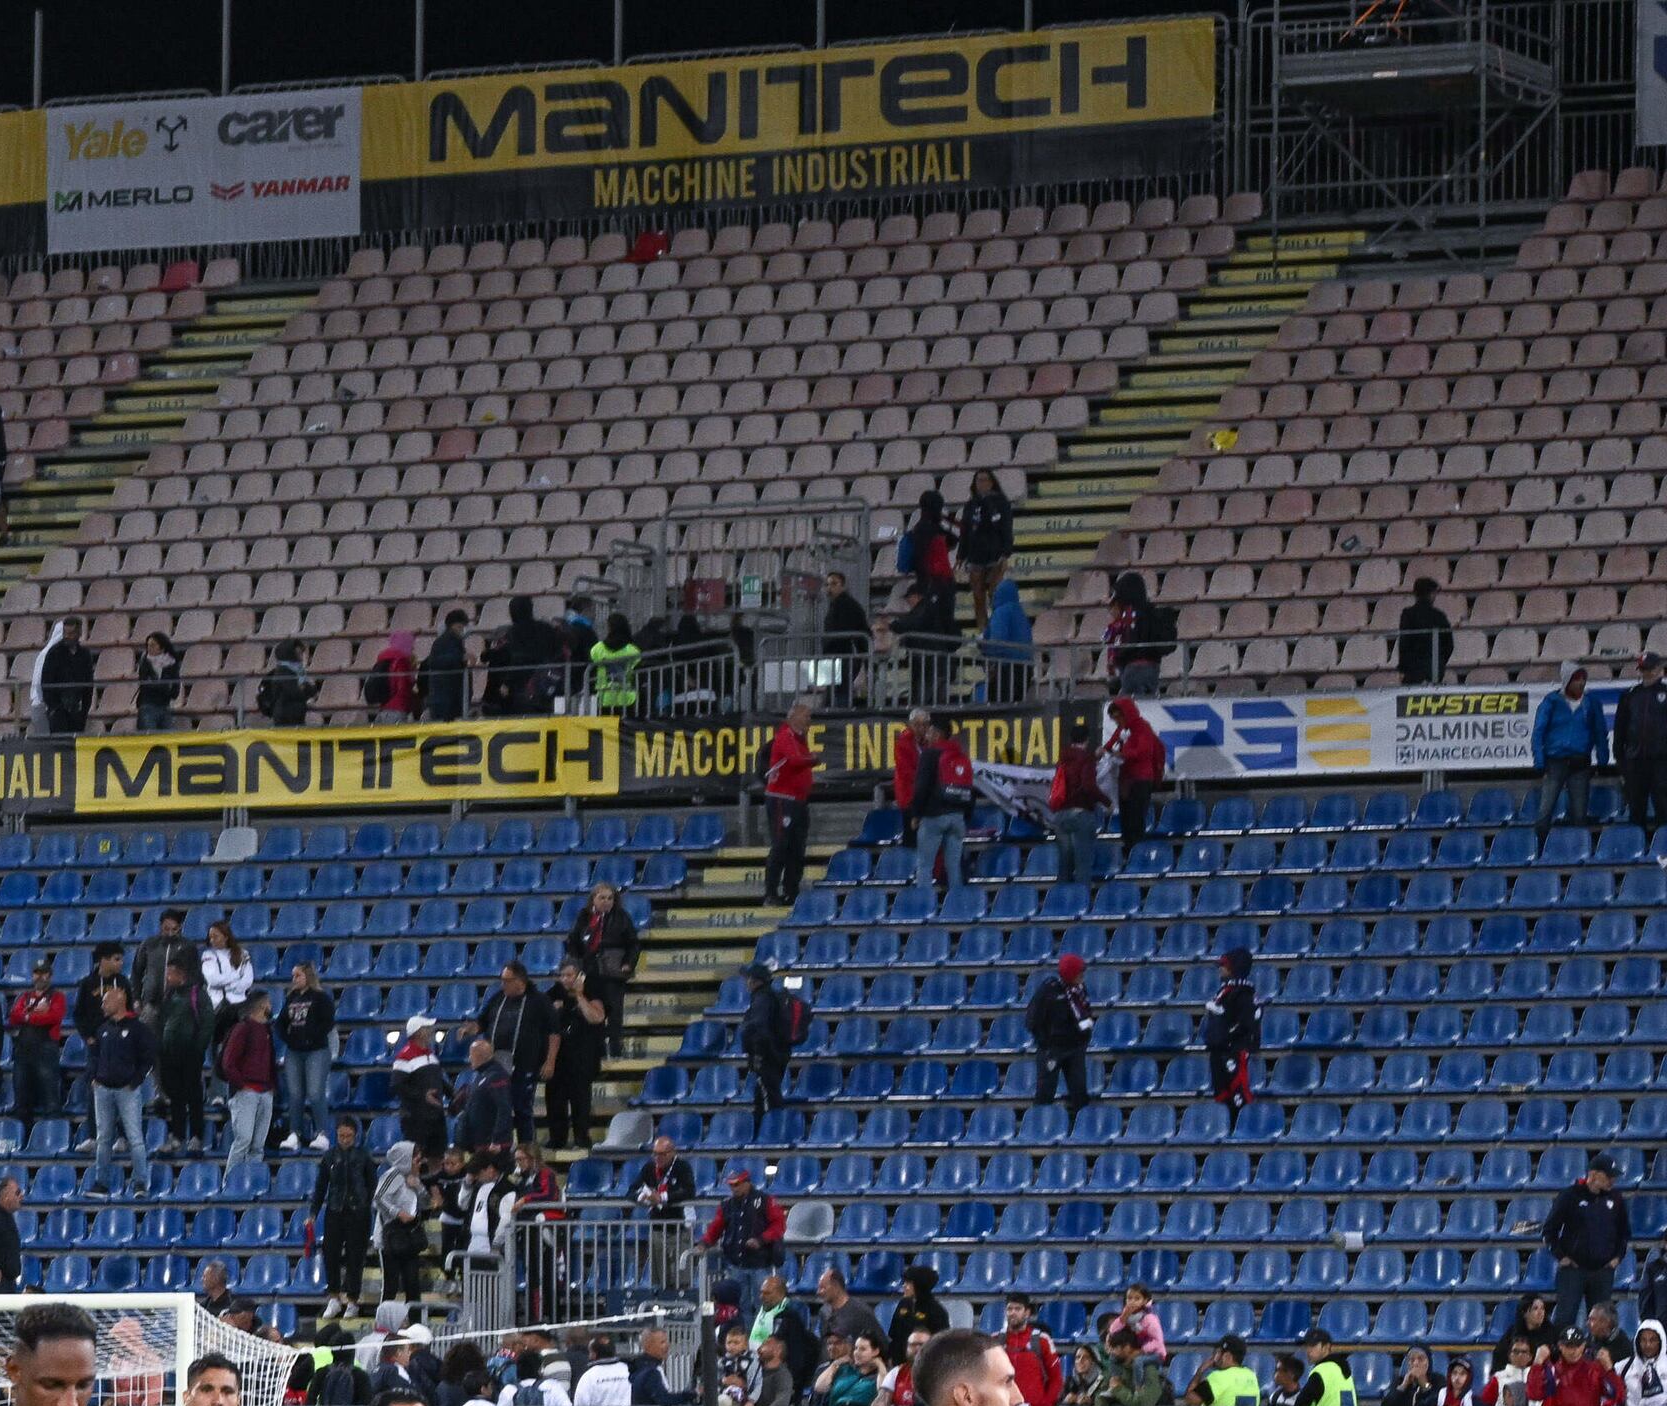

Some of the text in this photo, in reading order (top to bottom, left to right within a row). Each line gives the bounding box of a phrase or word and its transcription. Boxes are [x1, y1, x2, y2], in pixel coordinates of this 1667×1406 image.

[64, 119, 149, 161] Yale
[252, 175, 351, 198] YANMAR
[593, 140, 973, 209] MACCHINE INDUSTRIALI
[87, 185, 194, 209] MERLO
[1405, 693, 1521, 717] HYSTER
[1396, 720, 1506, 742] DALMINE
[635, 724, 826, 778] MACCHIE
[1417, 745, 1530, 762] MARCEGAGLIA
